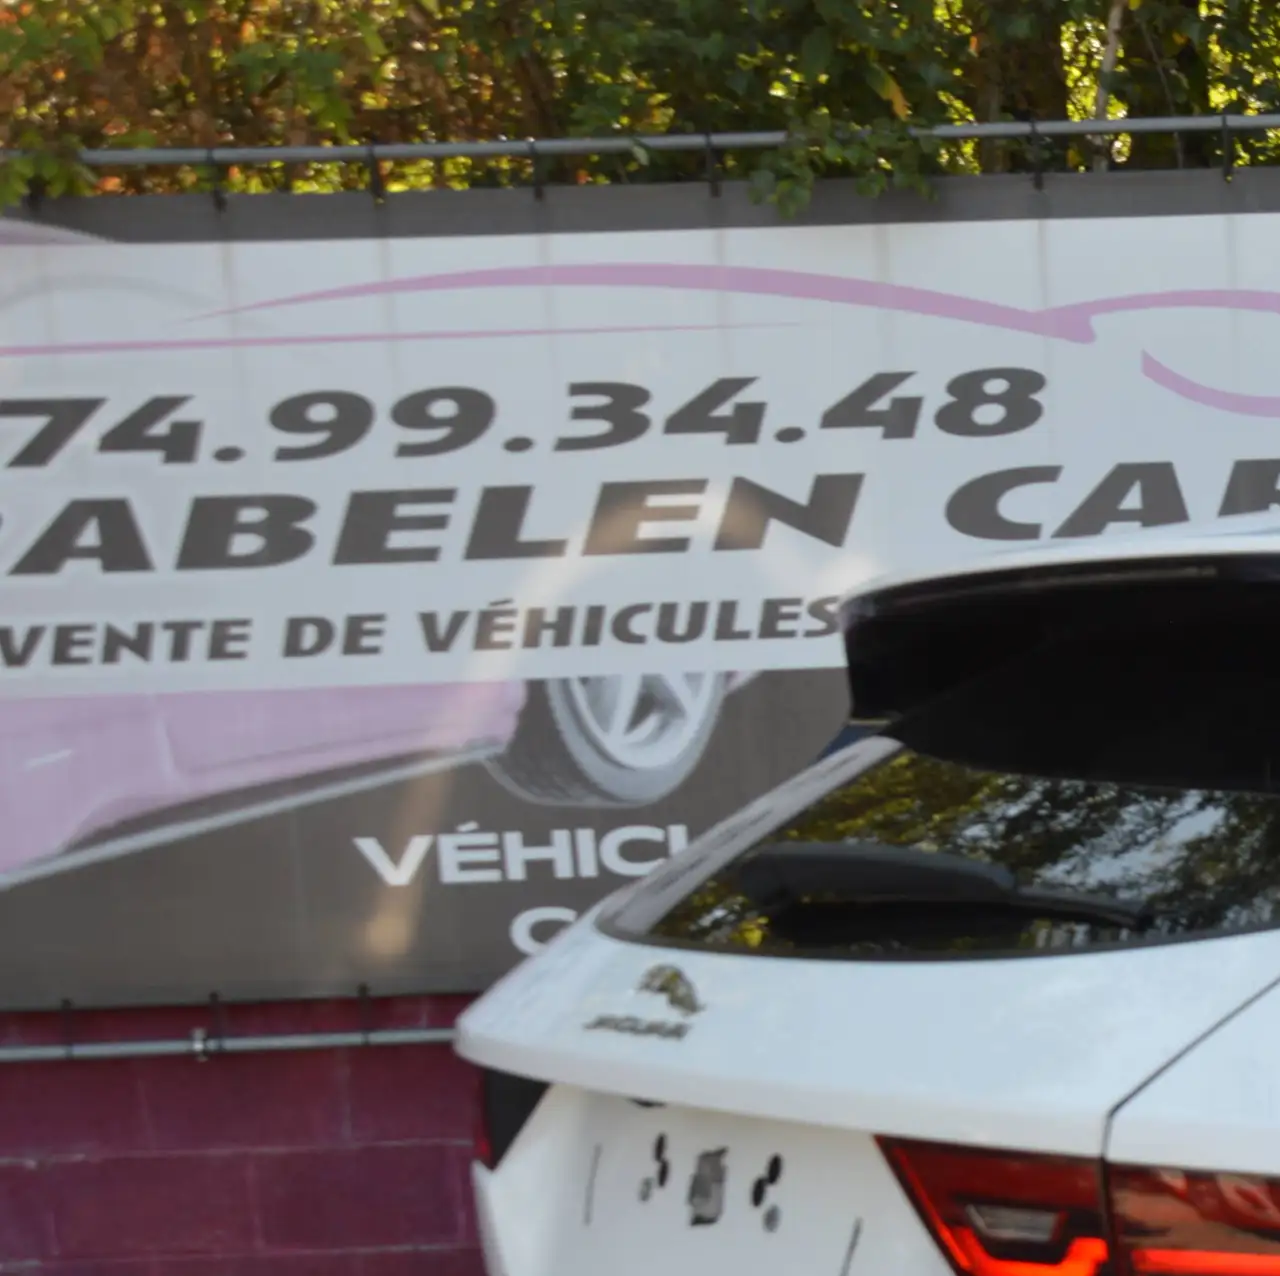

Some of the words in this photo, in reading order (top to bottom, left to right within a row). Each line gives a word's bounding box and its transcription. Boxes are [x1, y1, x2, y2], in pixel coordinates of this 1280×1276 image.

[0, 473, 865, 574] ABELEN
[0, 618, 252, 666] VENTE
[283, 614, 388, 656] DE
[418, 598, 841, 652] VÉHICULES
